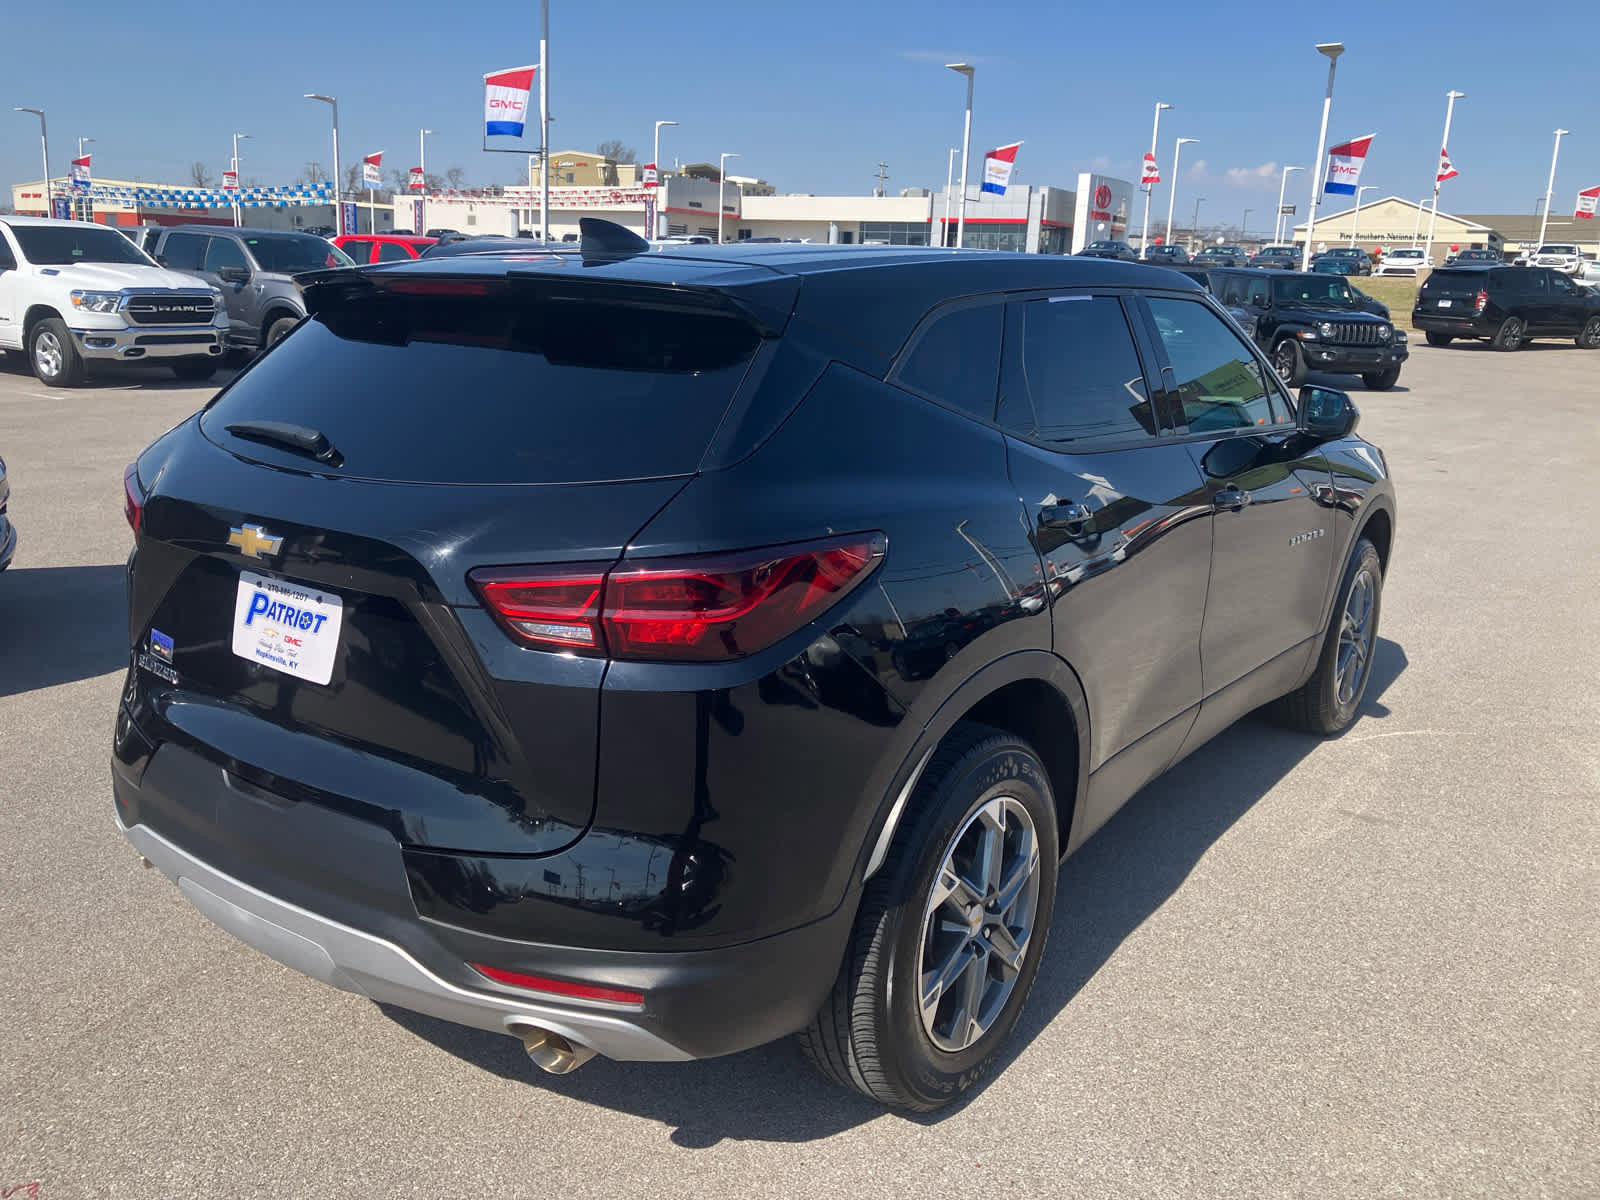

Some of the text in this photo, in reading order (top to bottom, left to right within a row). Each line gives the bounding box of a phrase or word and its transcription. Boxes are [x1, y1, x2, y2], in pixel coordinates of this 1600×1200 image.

[489, 99, 523, 110] GMC
[1331, 165, 1358, 175] GMC
[1340, 232, 1355, 240] Firs
[245, 591, 328, 634] PATRIOT
[284, 635, 303, 647] GMC
[289, 660, 299, 670] KY
